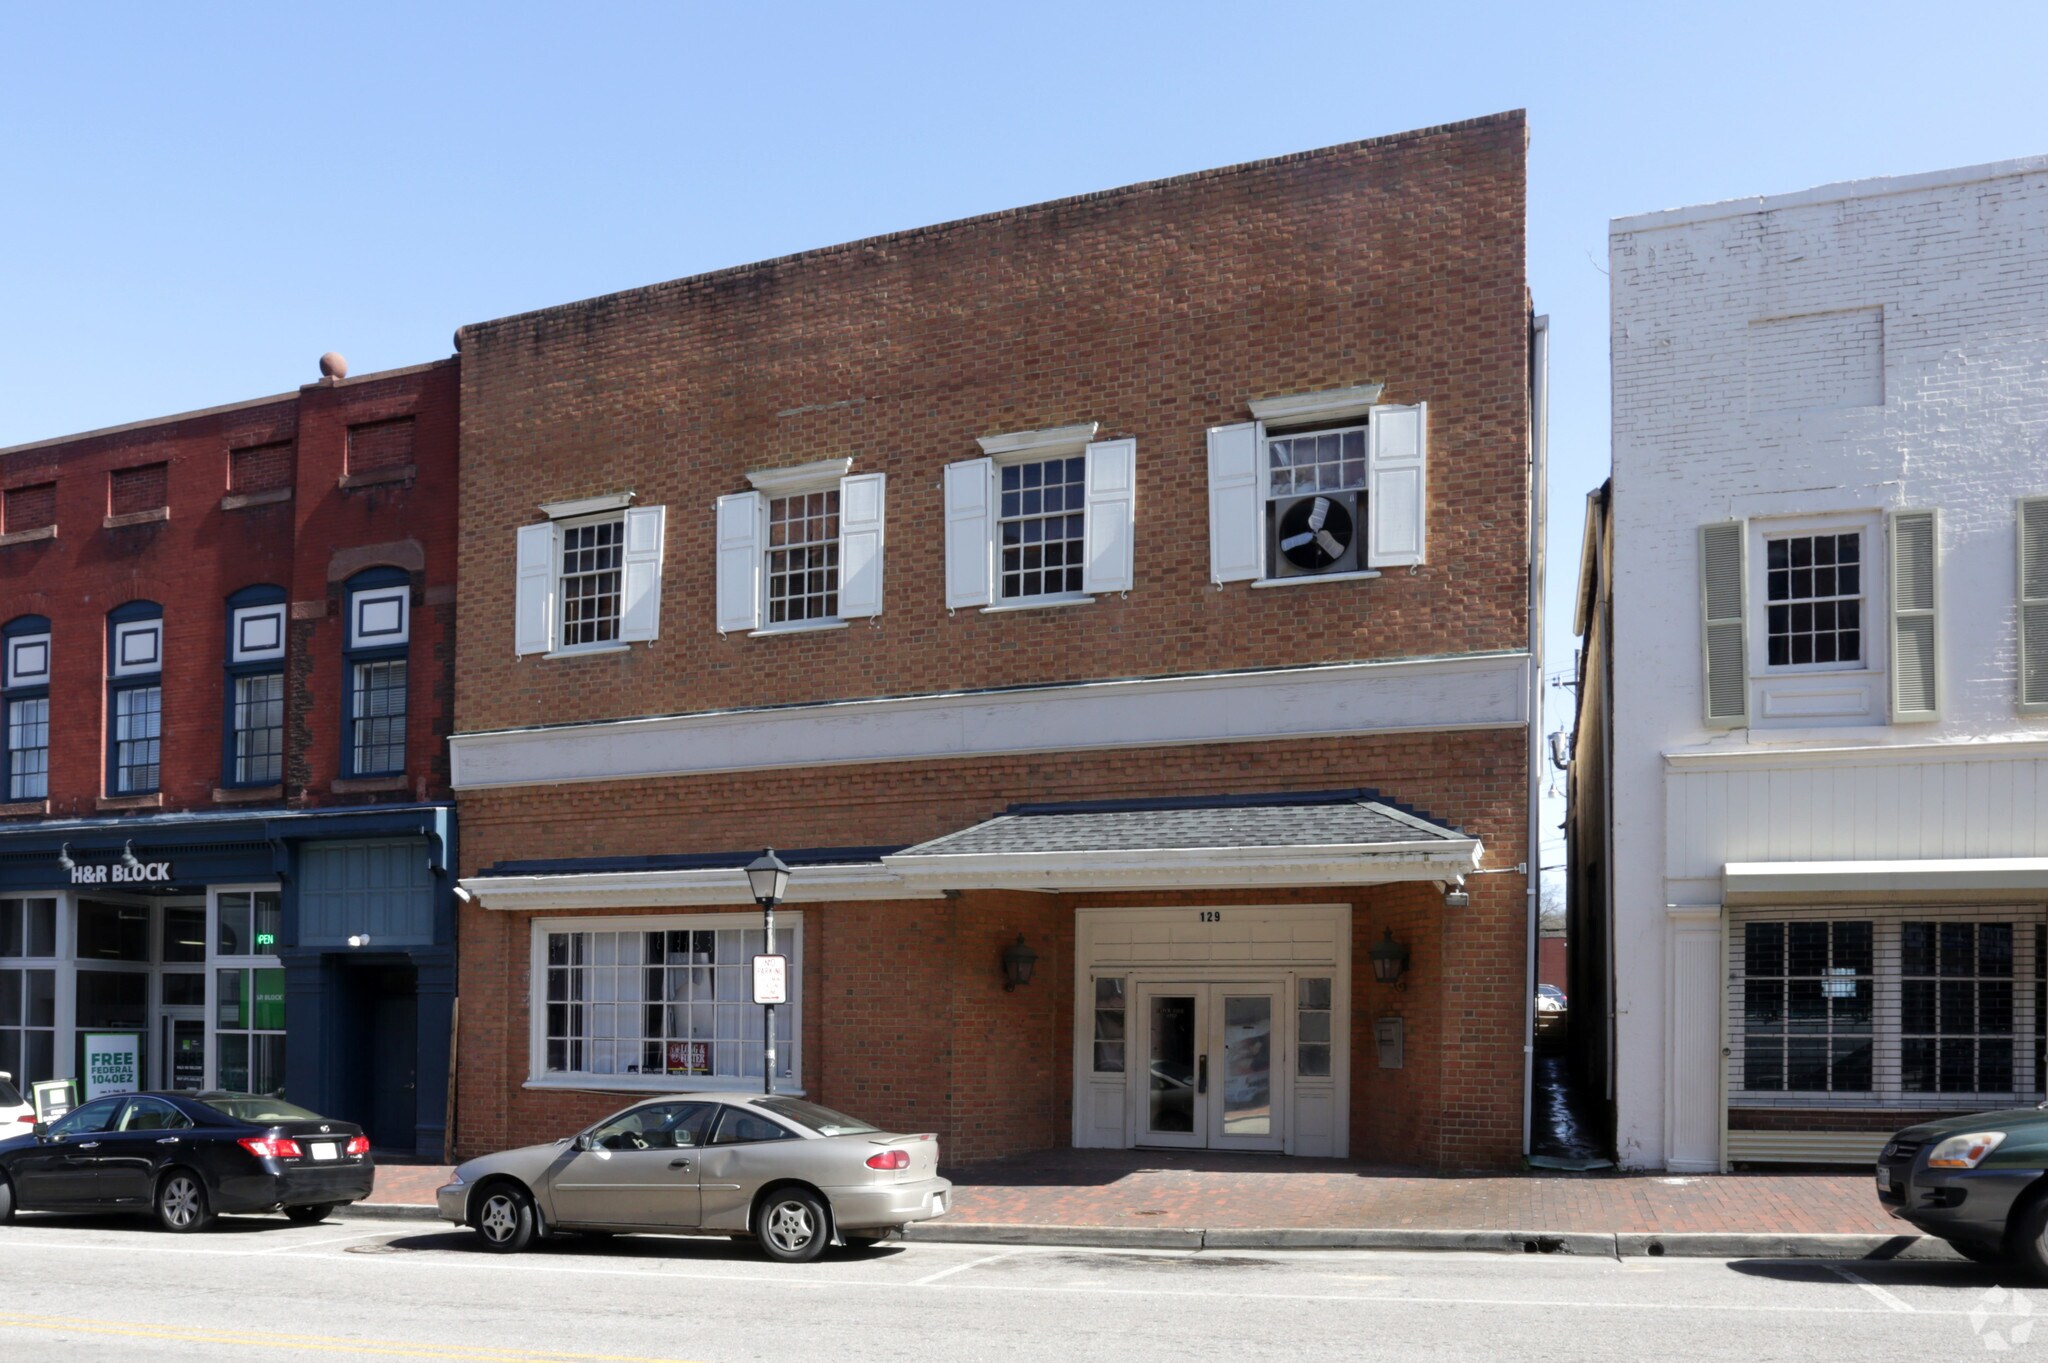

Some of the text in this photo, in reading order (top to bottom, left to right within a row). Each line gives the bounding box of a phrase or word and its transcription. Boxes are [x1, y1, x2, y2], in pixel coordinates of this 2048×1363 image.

[71, 862, 170, 884] H&R BLOCK
[1200, 911, 1220, 922] 129
[764, 959, 776, 967] NO
[91, 1052, 133, 1066] FREE
[91, 1066, 133, 1074] FEDERAL
[92, 1073, 133, 1084] 1040EZ
